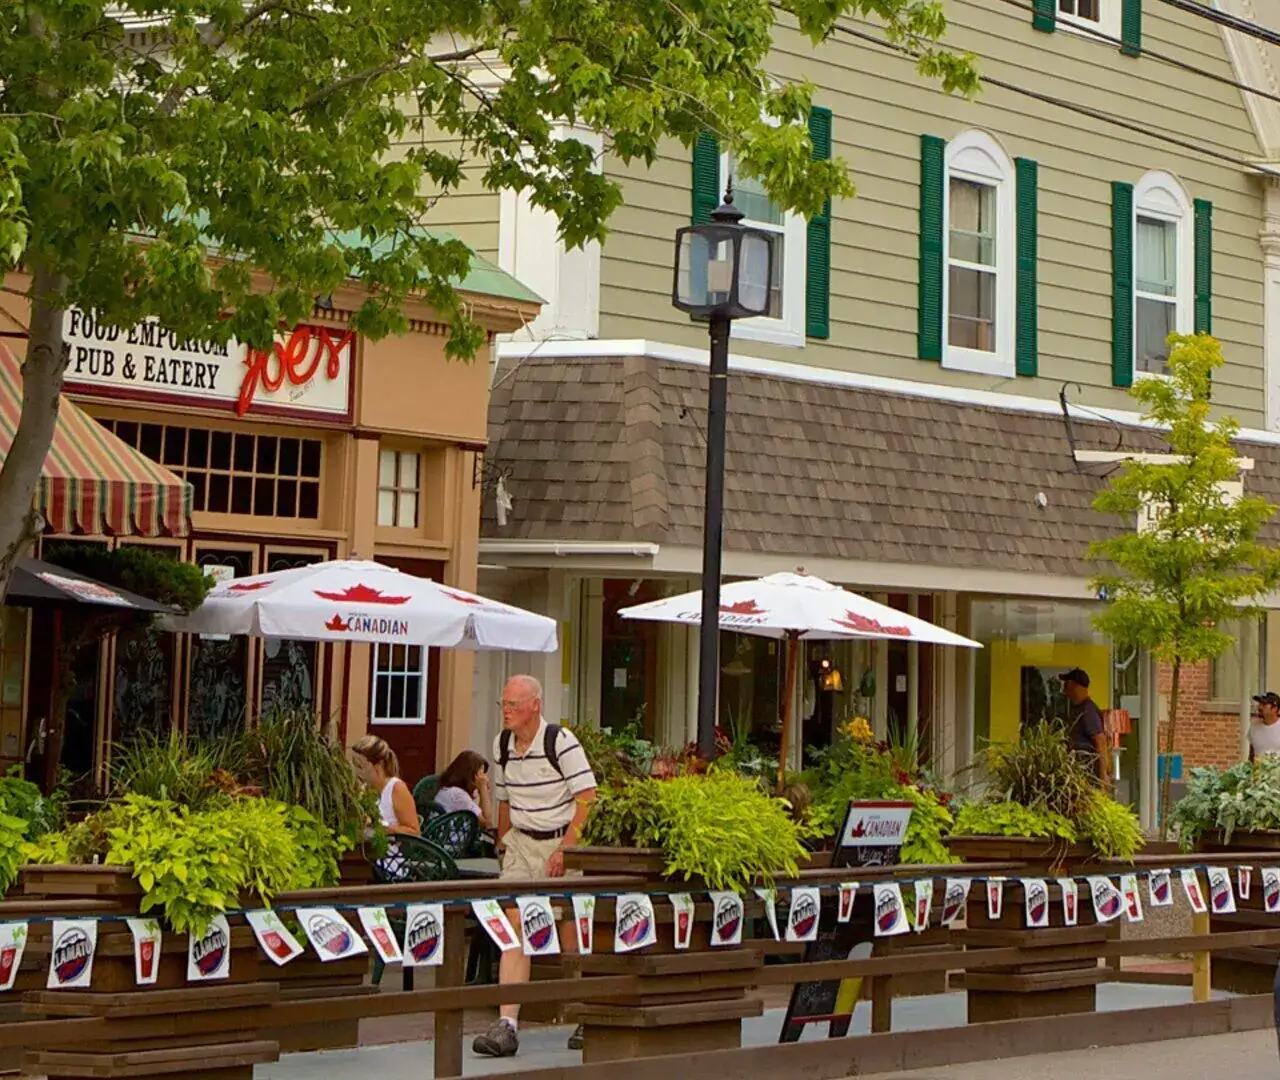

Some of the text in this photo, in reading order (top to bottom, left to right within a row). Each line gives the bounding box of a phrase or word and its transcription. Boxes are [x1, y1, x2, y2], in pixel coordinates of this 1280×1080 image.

[69, 310, 229, 357] FOOD EMPORIUM
[75, 347, 220, 389] PUB & EATERY
[347, 617, 409, 636] CANADIAN
